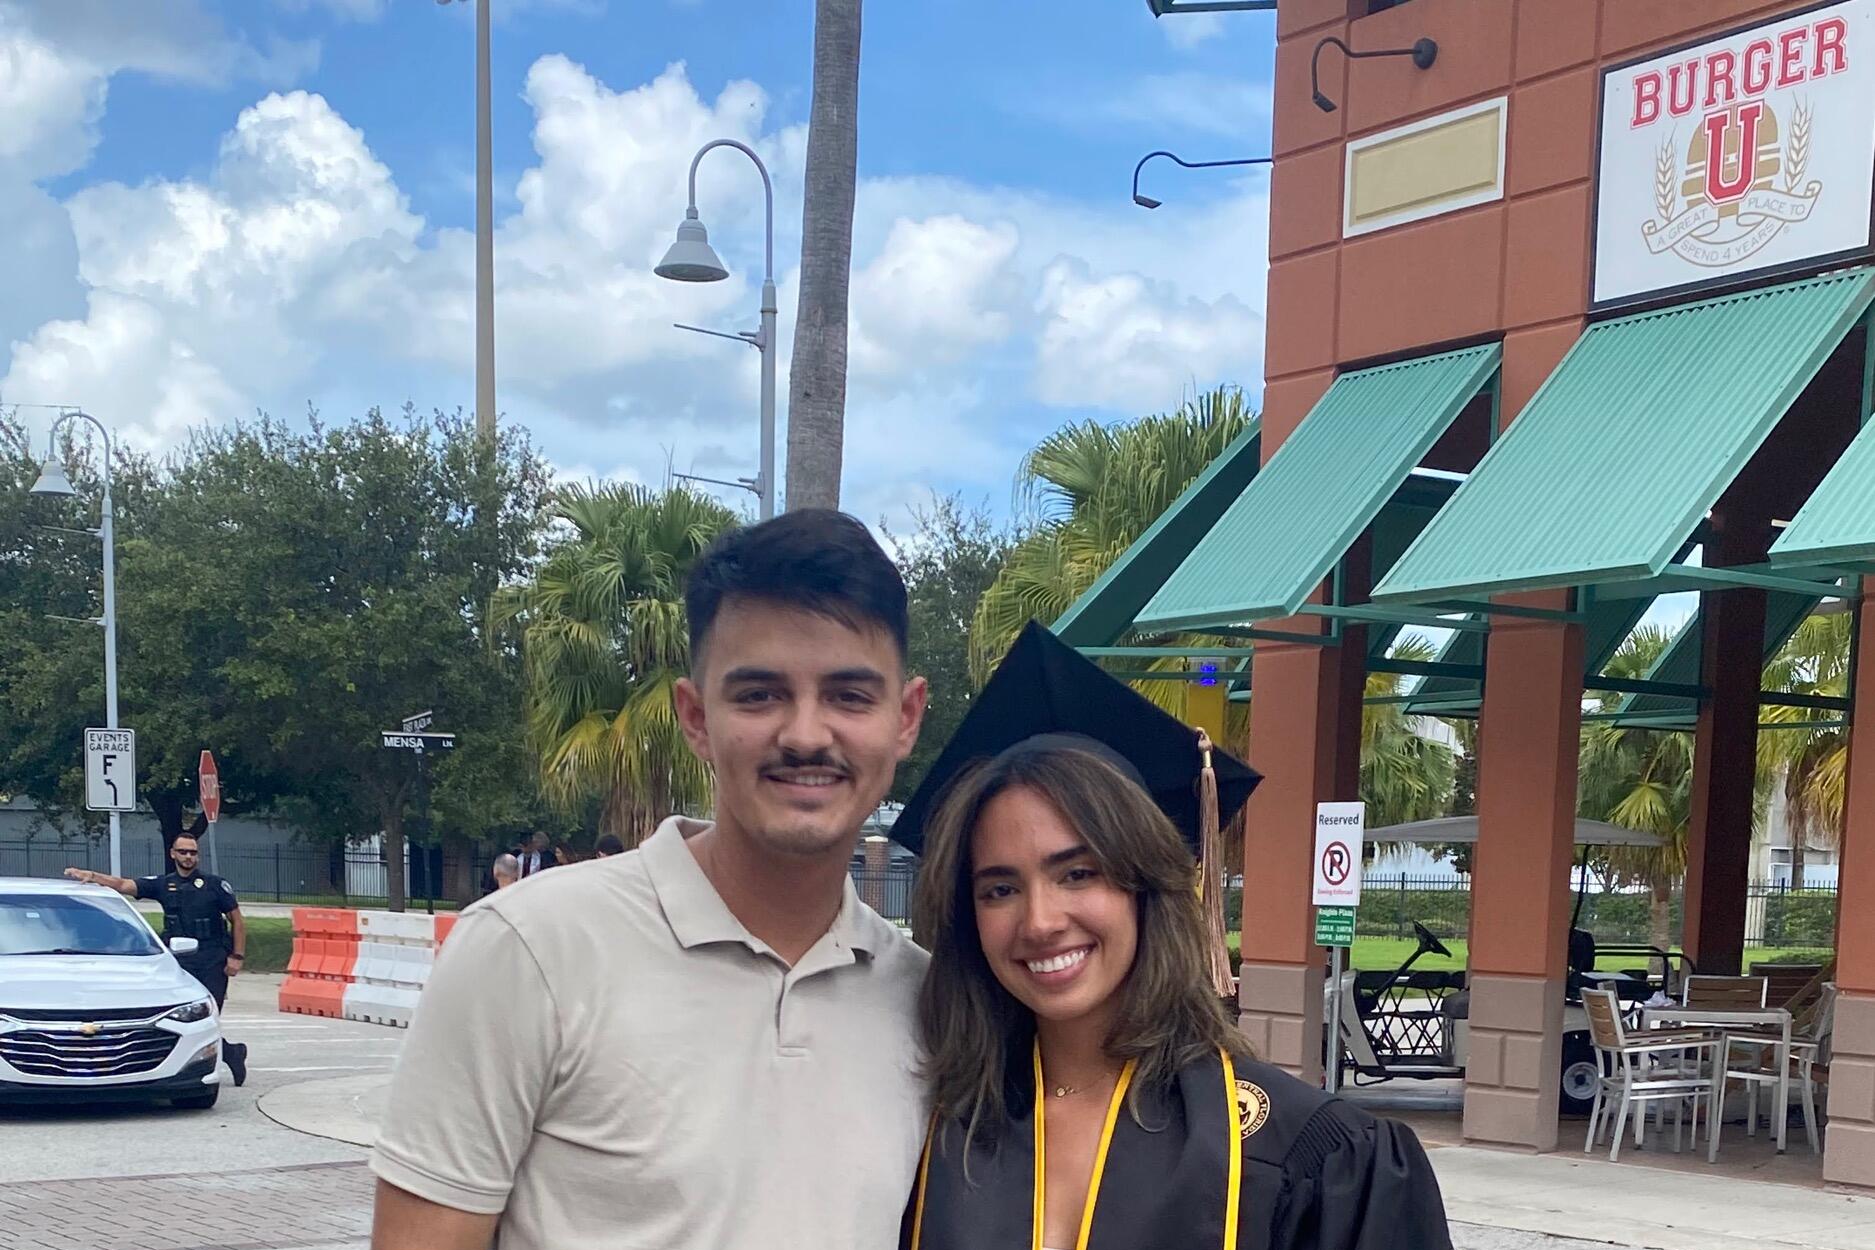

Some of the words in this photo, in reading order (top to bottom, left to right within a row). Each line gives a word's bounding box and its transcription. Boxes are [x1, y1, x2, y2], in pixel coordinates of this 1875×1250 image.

[1630, 16, 1848, 129] BURGER
[1704, 99, 1765, 208] U
[1656, 236, 1667, 247] A
[1668, 207, 1709, 239] GREAT
[1748, 197, 1787, 214] PLACE
[1790, 203, 1806, 216] TO
[1680, 239, 1719, 262] SPEND
[1721, 249, 1731, 260] 4
[1735, 222, 1776, 256] YEARS
[89, 743, 130, 752] GARAGE
[90, 733, 129, 742] EVENTS
[384, 736, 425, 748] MENSA
[103, 755, 117, 775] F
[201, 773, 218, 800] STOP
[1319, 813, 1360, 825] Reserved
[1235, 1081, 1267, 1104] ENTRAL
